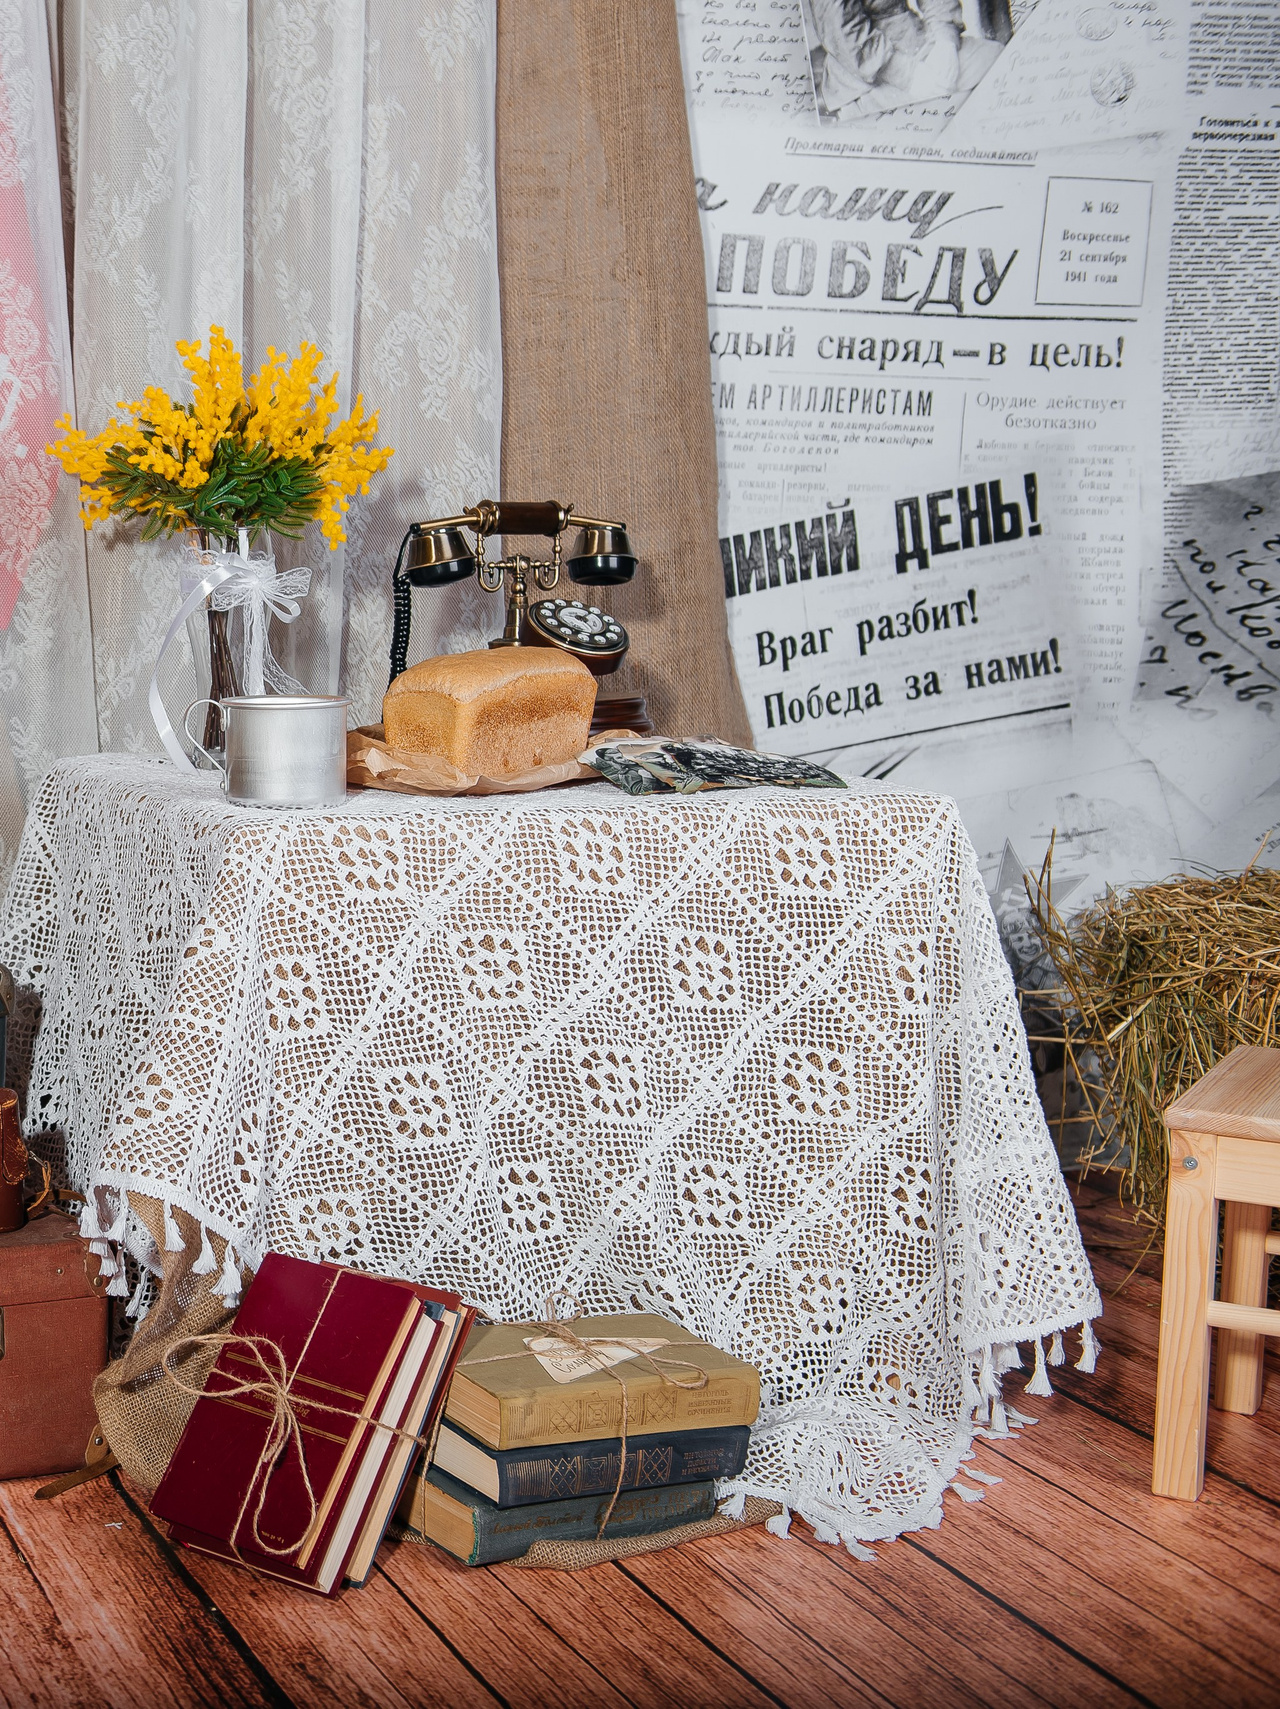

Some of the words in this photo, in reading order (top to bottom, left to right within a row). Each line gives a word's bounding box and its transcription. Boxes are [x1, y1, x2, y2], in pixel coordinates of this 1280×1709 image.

[784, 136, 864, 154] Пролетарии
[870, 145, 896, 155] всех
[752, 182, 1004, 239] нашу
[1100, 202, 1119, 214] 162
[1062, 229, 1131, 245] Воскресенье
[1059, 249, 1072, 262] 21
[1079, 251, 1128, 266] сентября
[716, 233, 1019, 315] ПОБЕДУ
[1065, 271, 1087, 283] 1941
[1095, 274, 1119, 285] года
[818, 334, 945, 371] снаряд
[1029, 336, 1125, 373] цель!
[747, 384, 934, 417] АРТИЛЛЕРИСТАМ
[976, 392, 1037, 412] Орудие
[1045, 395, 1127, 414] действует
[745, 416, 813, 431] командиров
[830, 420, 935, 435] политработников
[1005, 413, 1097, 431] безотказно
[864, 433, 934, 448] командиром
[894, 472, 1042, 575] ДЕНЬ!
[755, 627, 834, 672] Враг
[856, 589, 979, 656] разбит!
[764, 684, 884, 729] Победа
[904, 670, 942, 700] за
[964, 638, 1063, 689] нами!
